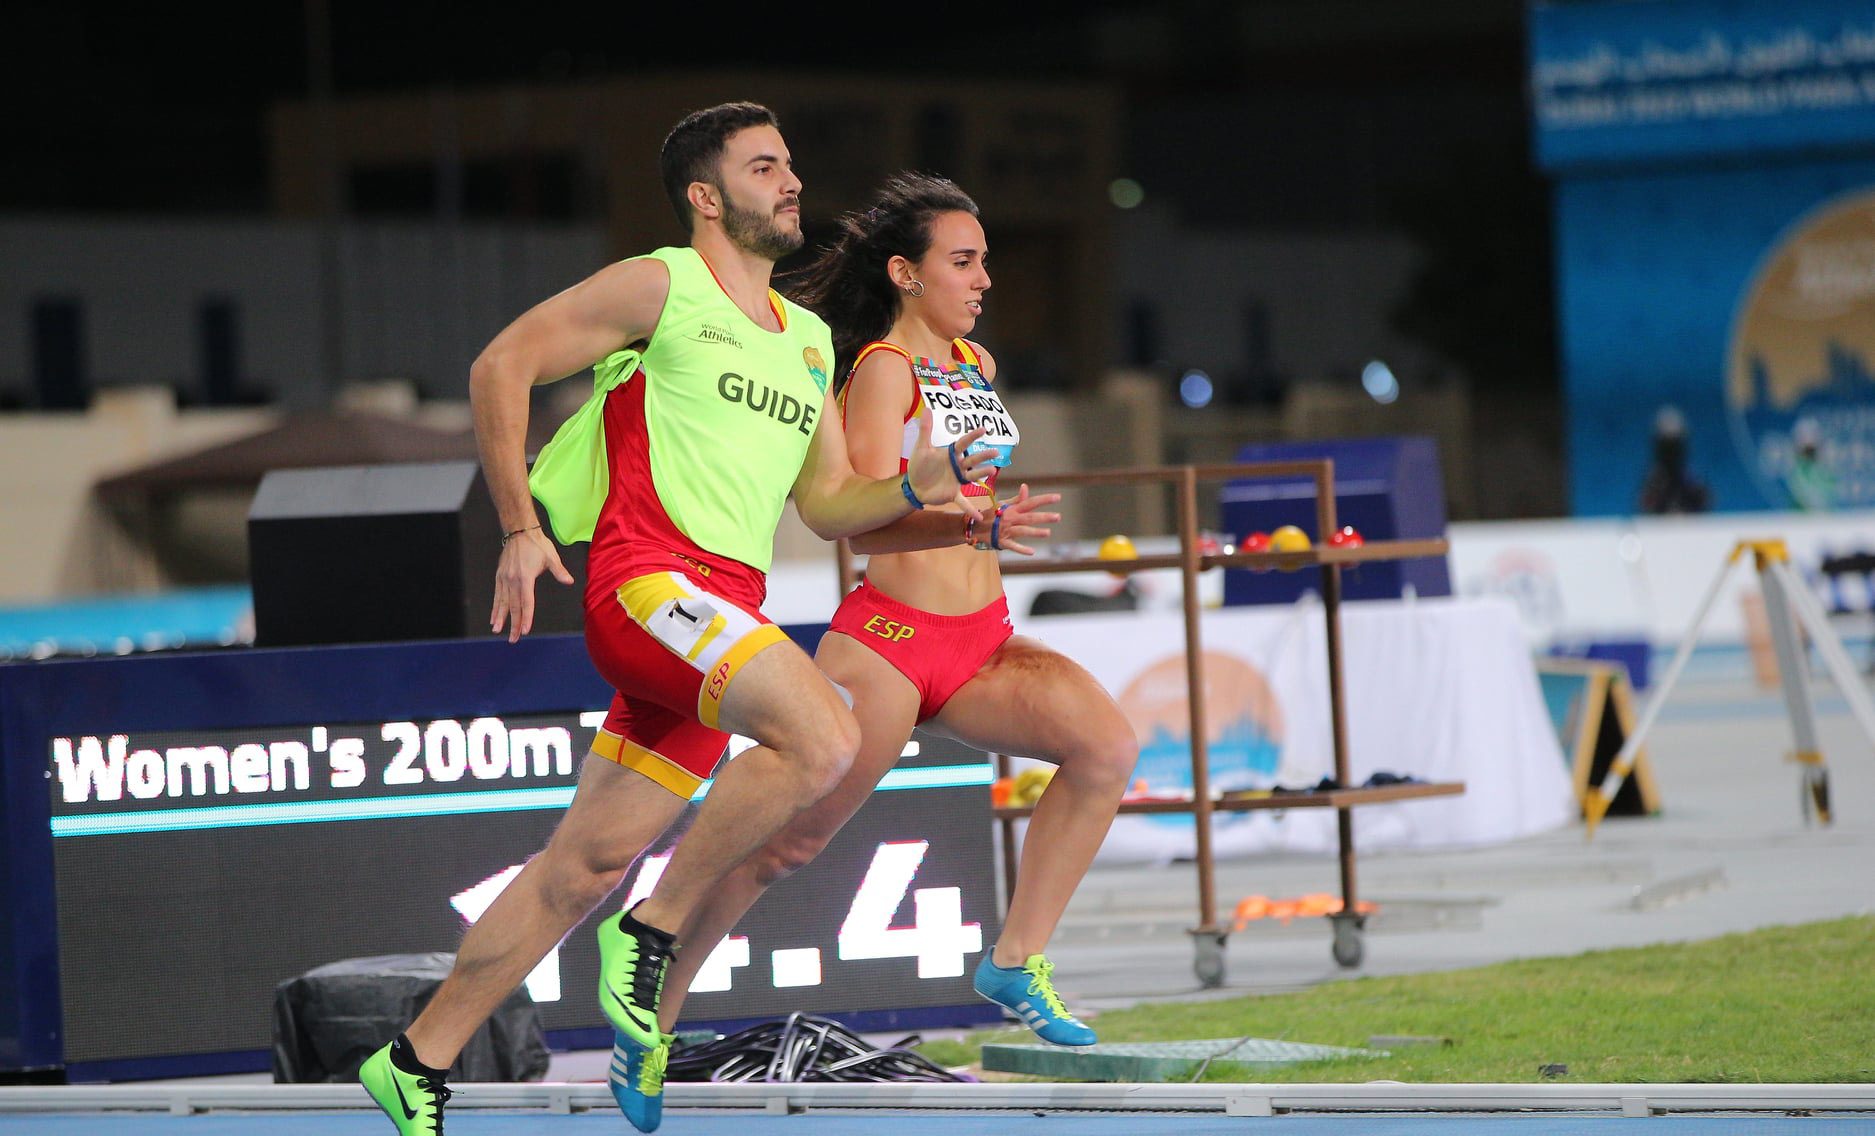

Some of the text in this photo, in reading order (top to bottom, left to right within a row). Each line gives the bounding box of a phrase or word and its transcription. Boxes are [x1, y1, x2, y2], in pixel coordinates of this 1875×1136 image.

[698, 329, 743, 350] Athletics
[718, 372, 816, 436] GUIDE
[863, 614, 915, 643] ESP
[708, 662, 731, 701] ESP
[52, 725, 366, 803] Women's
[381, 716, 573, 785] 200m
